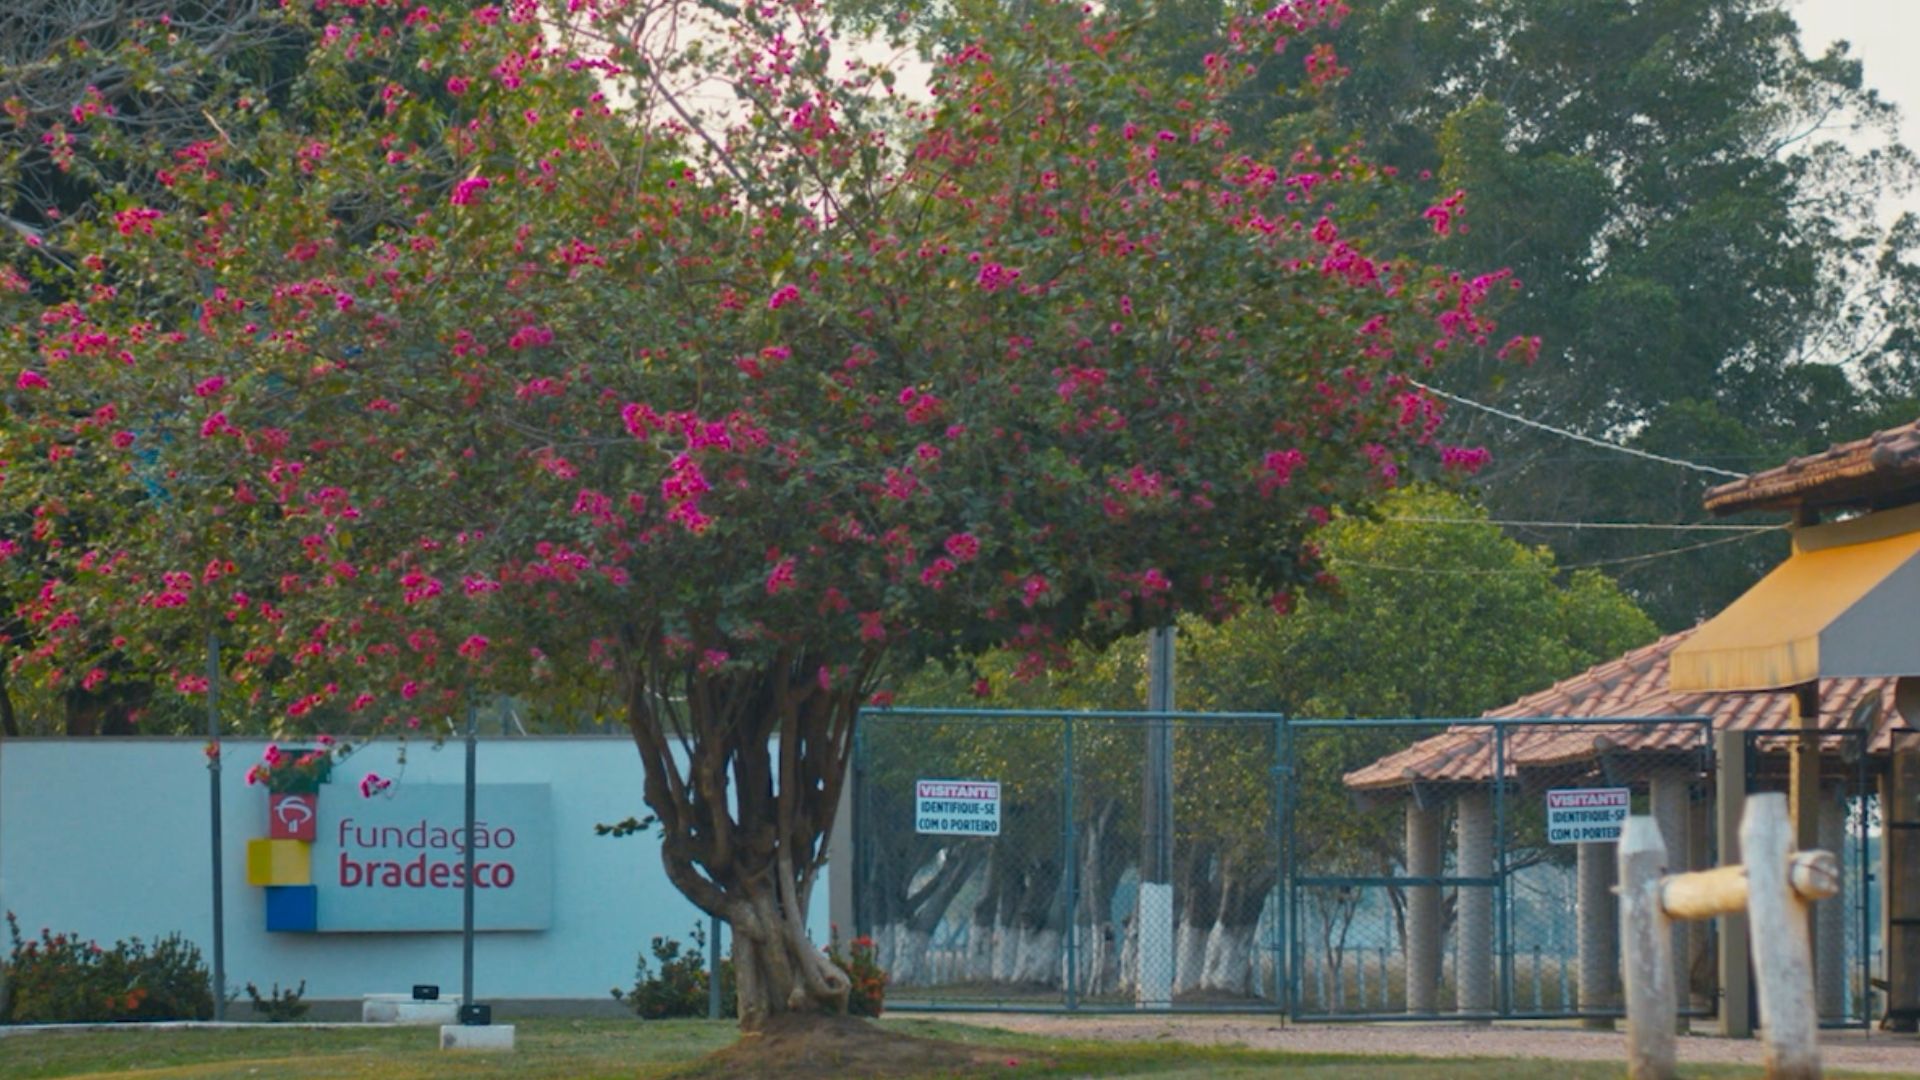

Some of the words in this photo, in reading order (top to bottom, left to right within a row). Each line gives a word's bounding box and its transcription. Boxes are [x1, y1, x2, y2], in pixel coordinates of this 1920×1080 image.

[921, 784, 997, 798] VISITANTE
[1550, 793, 1625, 807] VISITANTE
[921, 801, 995, 814] IDENTIFIQUE-SE
[919, 818, 939, 830] COM
[941, 818, 948, 830] O
[950, 819, 997, 832] PORTEIRO
[338, 818, 515, 855] fundação
[1551, 828, 1571, 840] COM
[1573, 828, 1580, 839] O
[339, 852, 515, 888] bradesco
